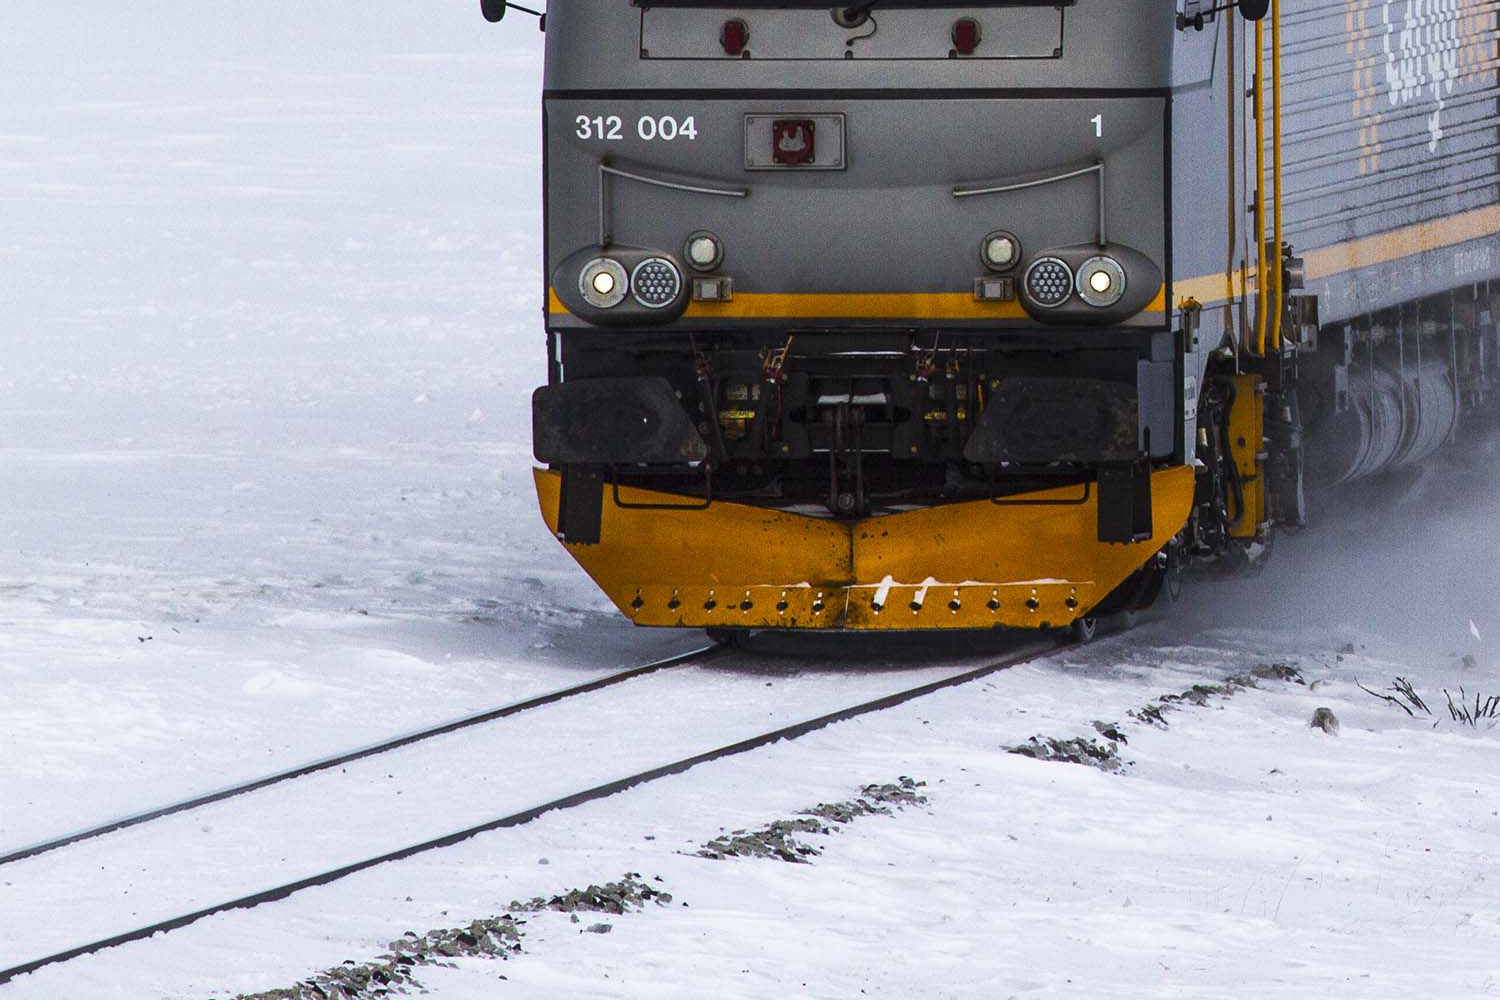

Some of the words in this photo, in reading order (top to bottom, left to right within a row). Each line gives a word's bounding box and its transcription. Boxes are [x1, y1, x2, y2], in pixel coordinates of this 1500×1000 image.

[575, 115, 623, 140] 312
[637, 115, 698, 141] 004
[1090, 114, 1102, 137] 1
